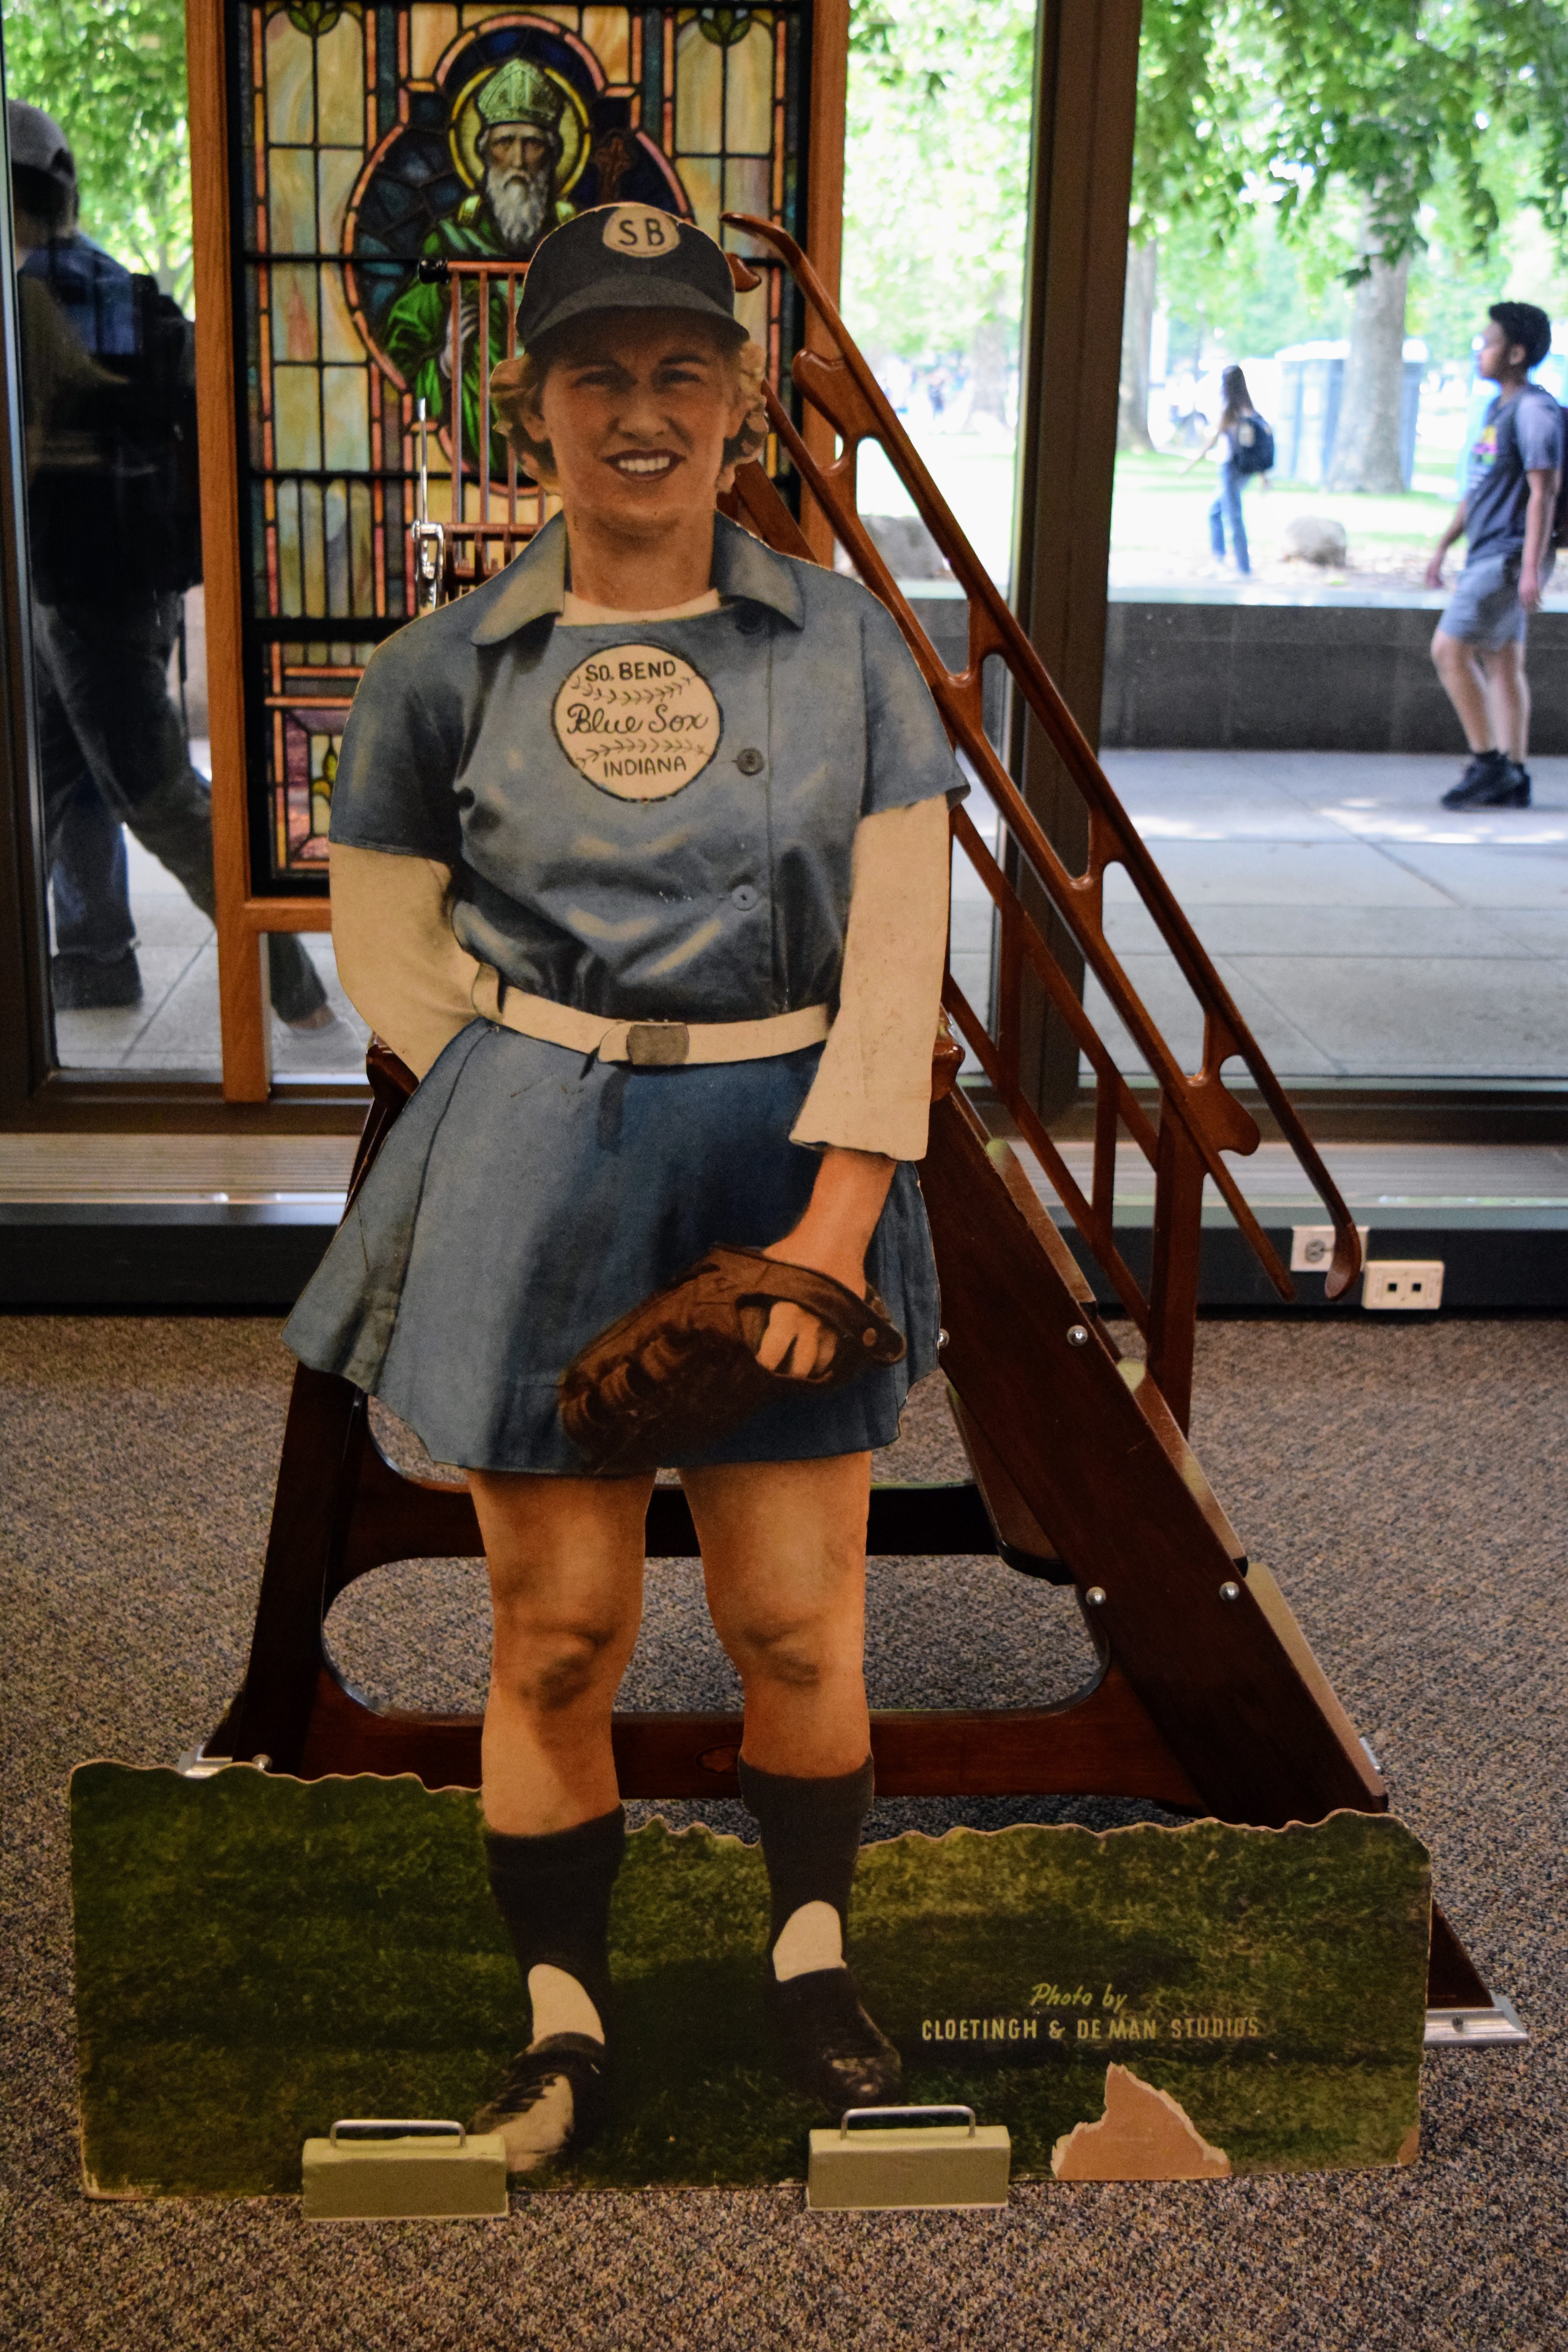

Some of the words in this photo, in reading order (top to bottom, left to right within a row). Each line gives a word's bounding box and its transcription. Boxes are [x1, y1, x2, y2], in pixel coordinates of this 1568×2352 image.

[618, 218, 665, 246] SB
[585, 664, 614, 681] SO.
[619, 660, 676, 681] BEND
[567, 703, 643, 734] Blue
[648, 704, 708, 733] Sox
[604, 756, 687, 778] INDIANA
[1029, 1983, 1093, 2007] Photo
[1102, 1984, 1128, 2013] by
[922, 2018, 1037, 2041] CLOETINGH
[1049, 2019, 1064, 2040] &
[1077, 2018, 1101, 2040] DE
[1110, 2018, 1157, 2040] MAN
[1170, 2016, 1259, 2038] STUDIOS
